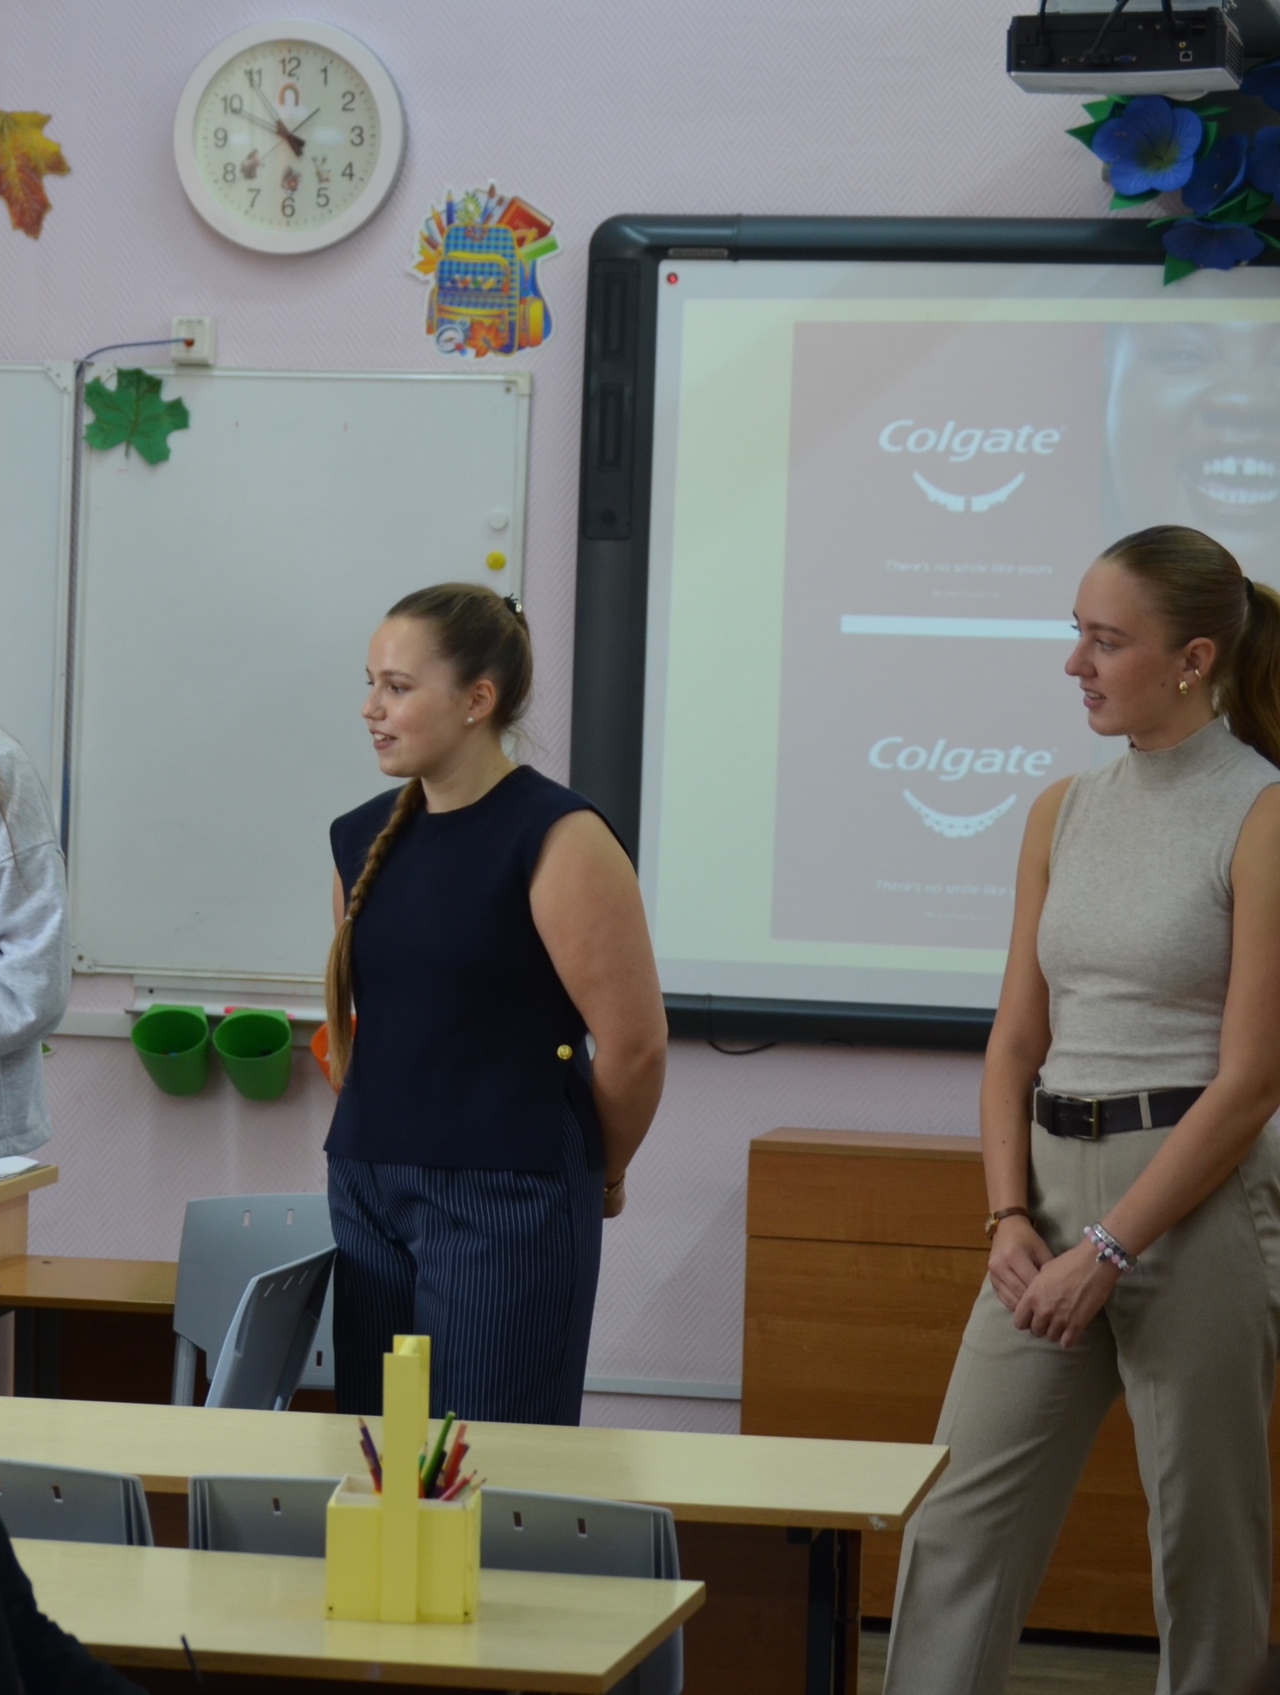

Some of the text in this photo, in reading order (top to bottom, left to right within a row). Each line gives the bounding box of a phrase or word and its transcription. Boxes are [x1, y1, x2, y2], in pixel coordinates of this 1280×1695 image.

[279, 56, 301, 77] 12
[320, 65, 328, 86] 1
[245, 67, 262, 88] 11
[221, 93, 243, 114] 10
[341, 91, 355, 111] 2
[214, 127, 228, 148] 9
[350, 125, 364, 146] 3
[223, 162, 236, 183] 8
[341, 162, 355, 181] 4
[247, 187, 261, 208] 7
[281, 197, 295, 217] 6
[316, 187, 330, 208] 5
[878, 418, 1061, 463] Colgate
[934, 562, 951, 573] no
[868, 736, 1052, 781] Colgate
